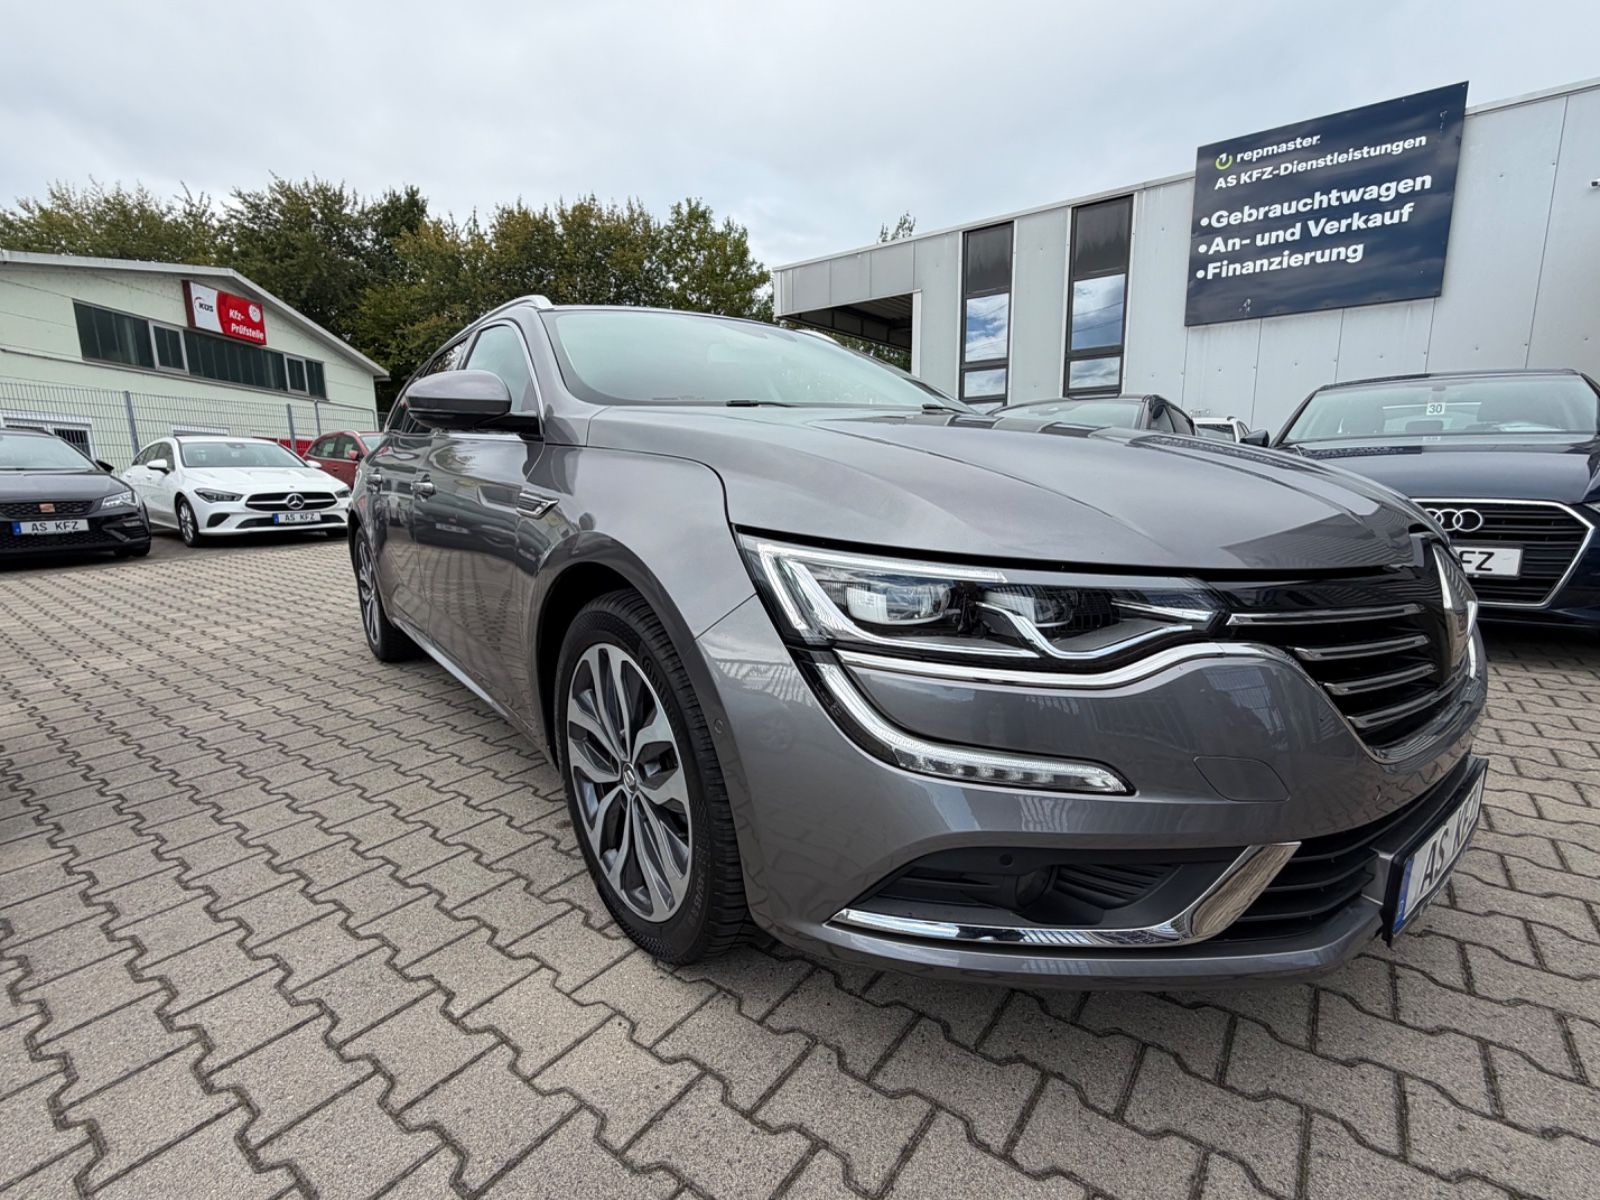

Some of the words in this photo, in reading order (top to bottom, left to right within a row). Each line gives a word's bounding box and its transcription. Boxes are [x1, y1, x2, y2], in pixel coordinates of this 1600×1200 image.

[1214, 174, 1238, 190] AS
[1240, 135, 1427, 184] KFZ-Dienstleistungen
[1255, 222, 1302, 247] und
[1307, 203, 1414, 239] Verkauf
[229, 309, 245, 320] Kfz-
[231, 323, 264, 340] Prüfstelle
[1428, 403, 1443, 414] 30
[31, 522, 48, 532] AS
[55, 521, 79, 531] KFZ
[1420, 825, 1449, 894] AS
